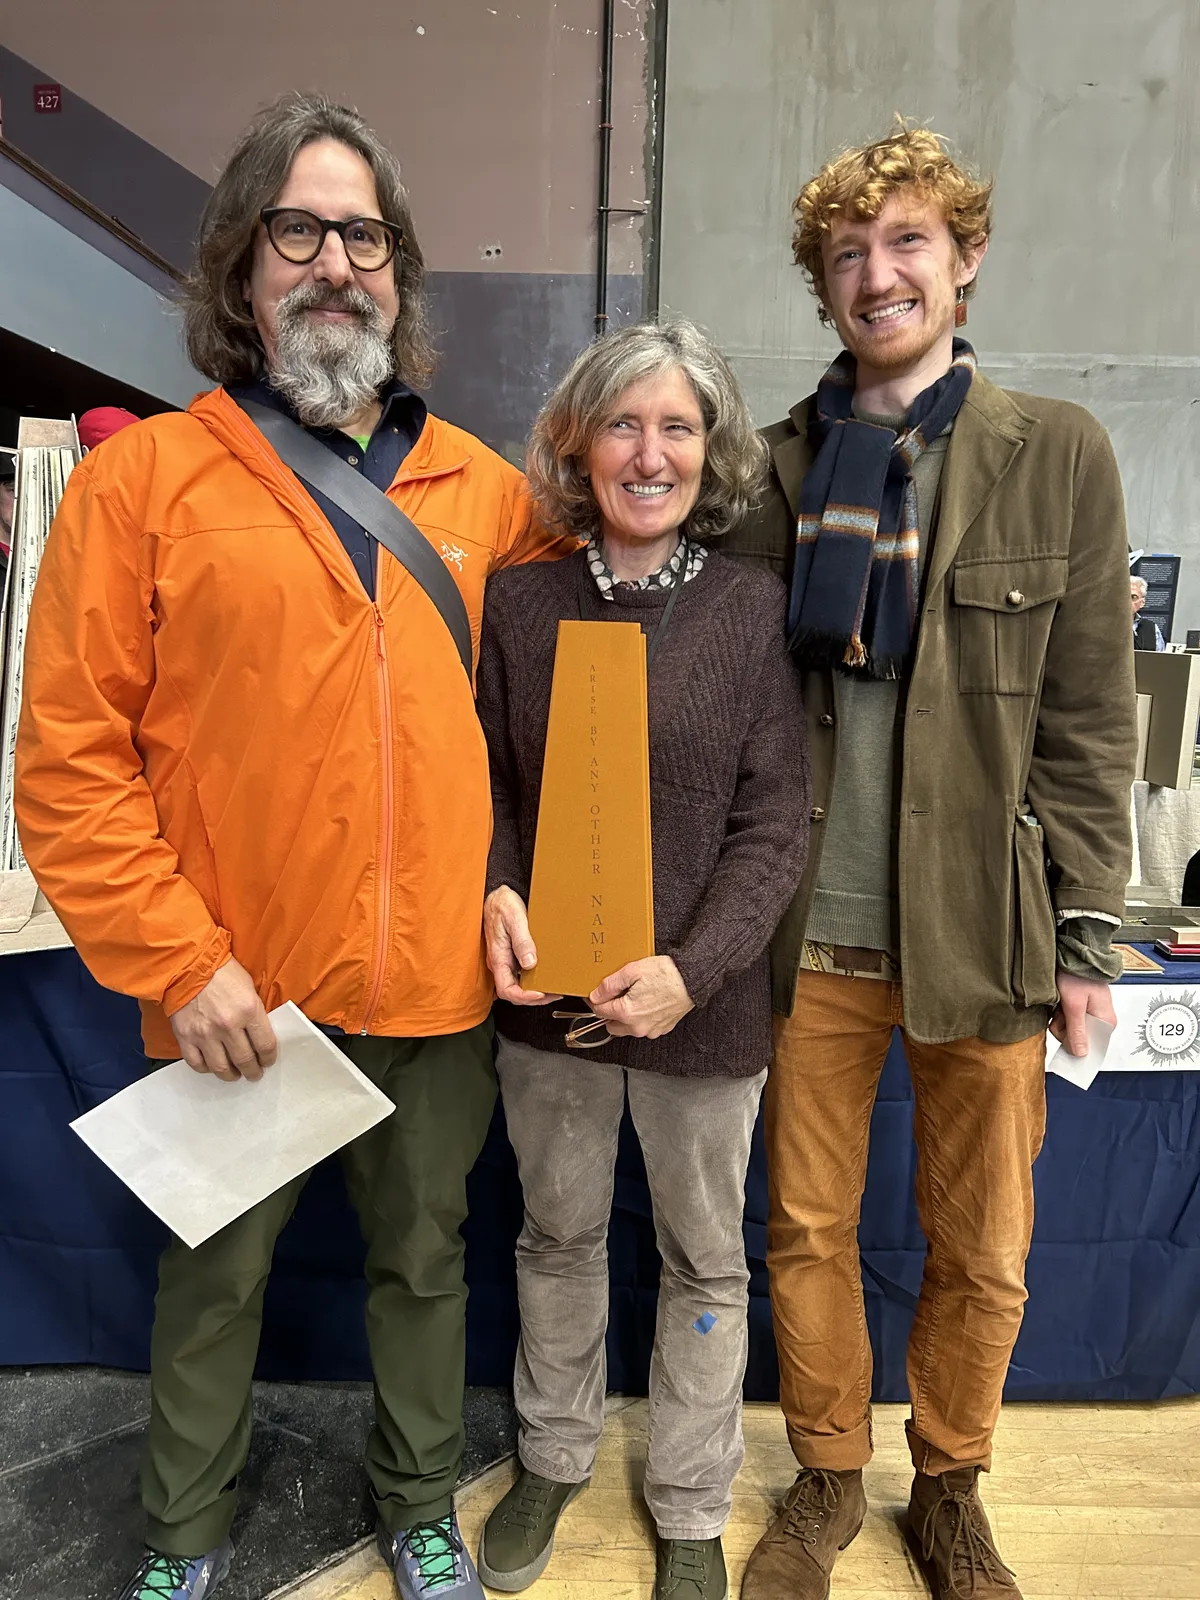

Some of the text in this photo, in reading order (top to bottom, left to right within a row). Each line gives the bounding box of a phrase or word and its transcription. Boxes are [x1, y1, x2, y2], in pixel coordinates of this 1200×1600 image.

[37, 95, 59, 108] 427
[589, 664, 605, 963] ARISE BY ANY OTHER NAME
[1159, 1023, 1185, 1036] 129
